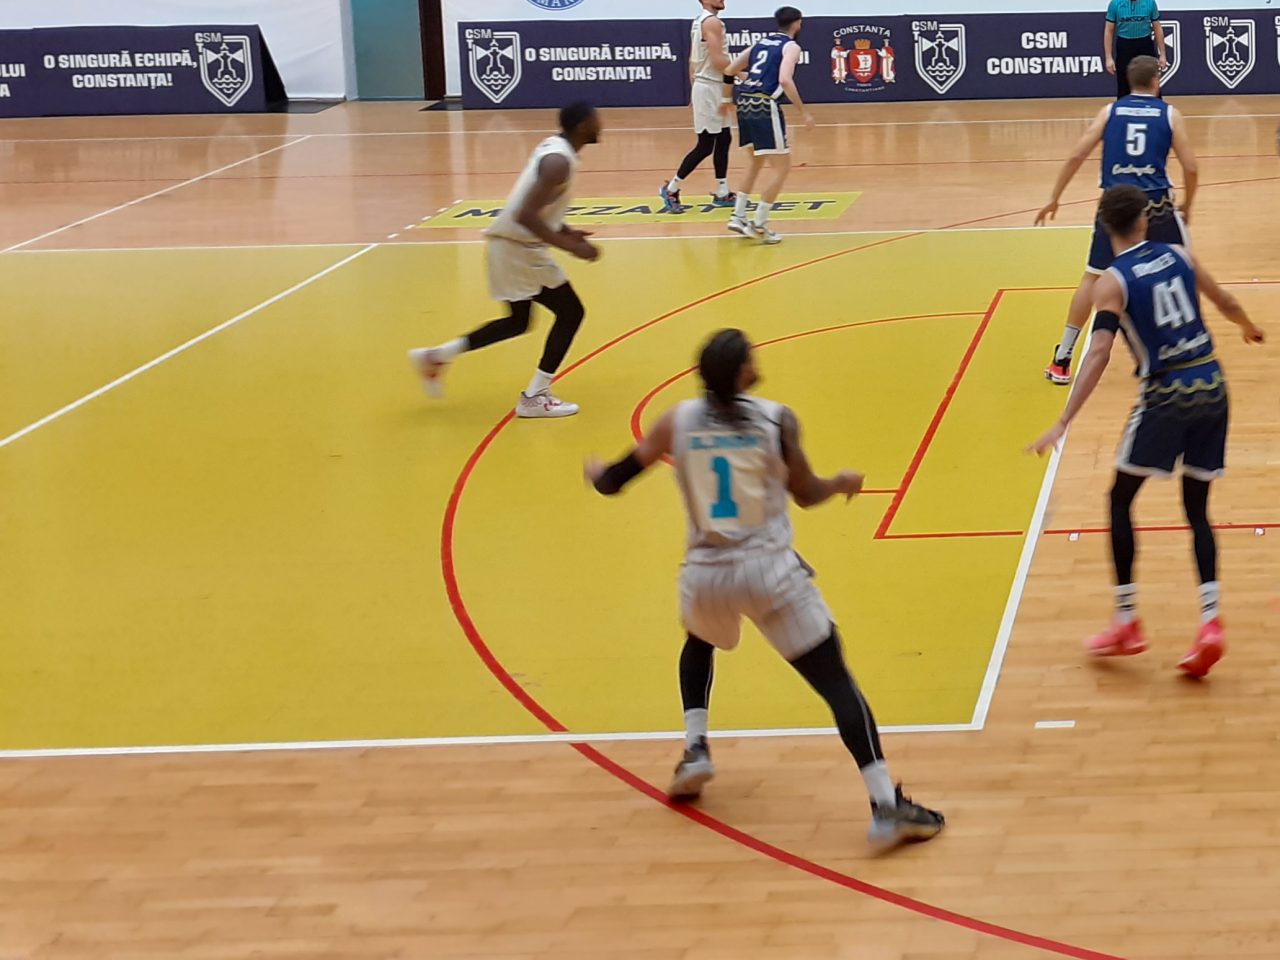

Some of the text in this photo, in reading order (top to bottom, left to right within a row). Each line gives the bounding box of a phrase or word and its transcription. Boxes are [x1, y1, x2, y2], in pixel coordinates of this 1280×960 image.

[911, 20, 938, 32] CSM
[1203, 16, 1229, 27] CSM
[194, 32, 222, 43] CSM
[465, 28, 492, 39] CSM
[1021, 31, 1068, 50] CSM
[43, 49, 198, 69] O SINGURĂ ECHIPĂ,
[524, 42, 677, 62] O SINGURĂ ECHIPĂ,
[750, 50, 768, 74] 2
[1126, 123, 1148, 156] 5
[1152, 275, 1197, 329] 41
[710, 456, 739, 518] 1
